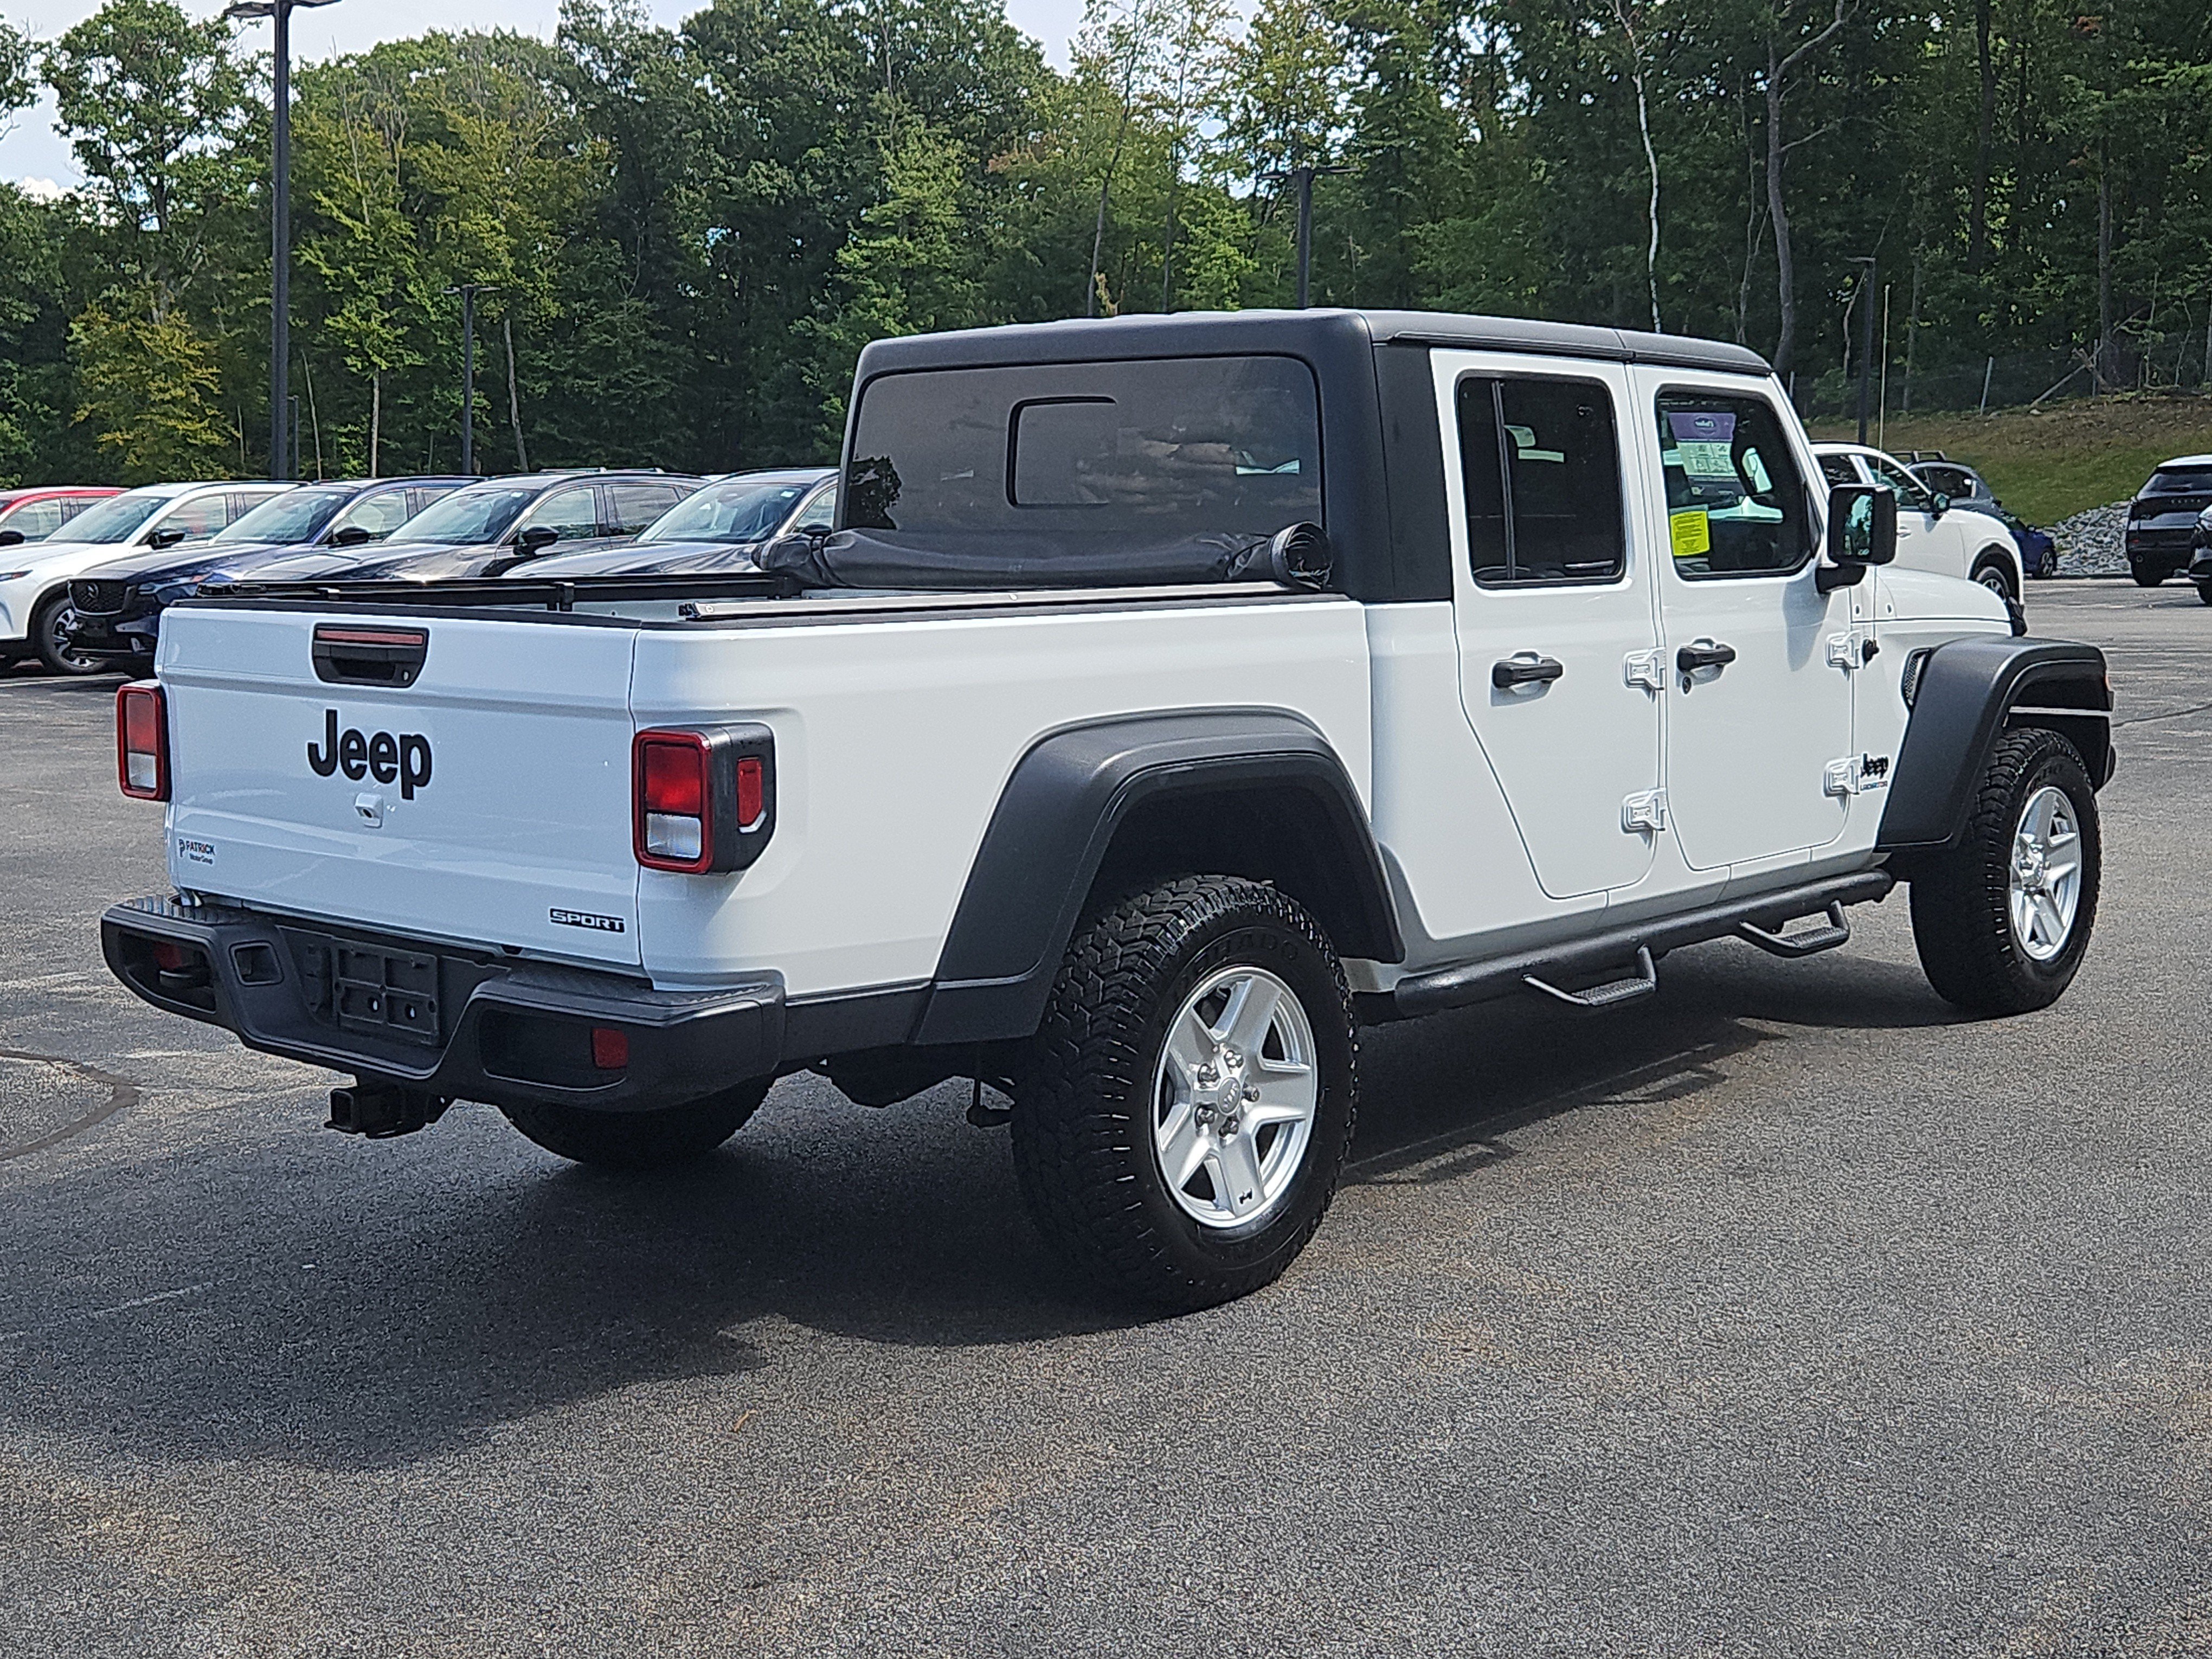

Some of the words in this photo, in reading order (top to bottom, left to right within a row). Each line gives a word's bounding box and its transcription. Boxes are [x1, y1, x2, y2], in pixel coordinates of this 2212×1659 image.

[307, 709, 432, 800] Jeep
[1860, 753, 1889, 779] Jeep
[186, 840, 216, 856] PATRICK
[551, 910, 624, 930] SPORT
